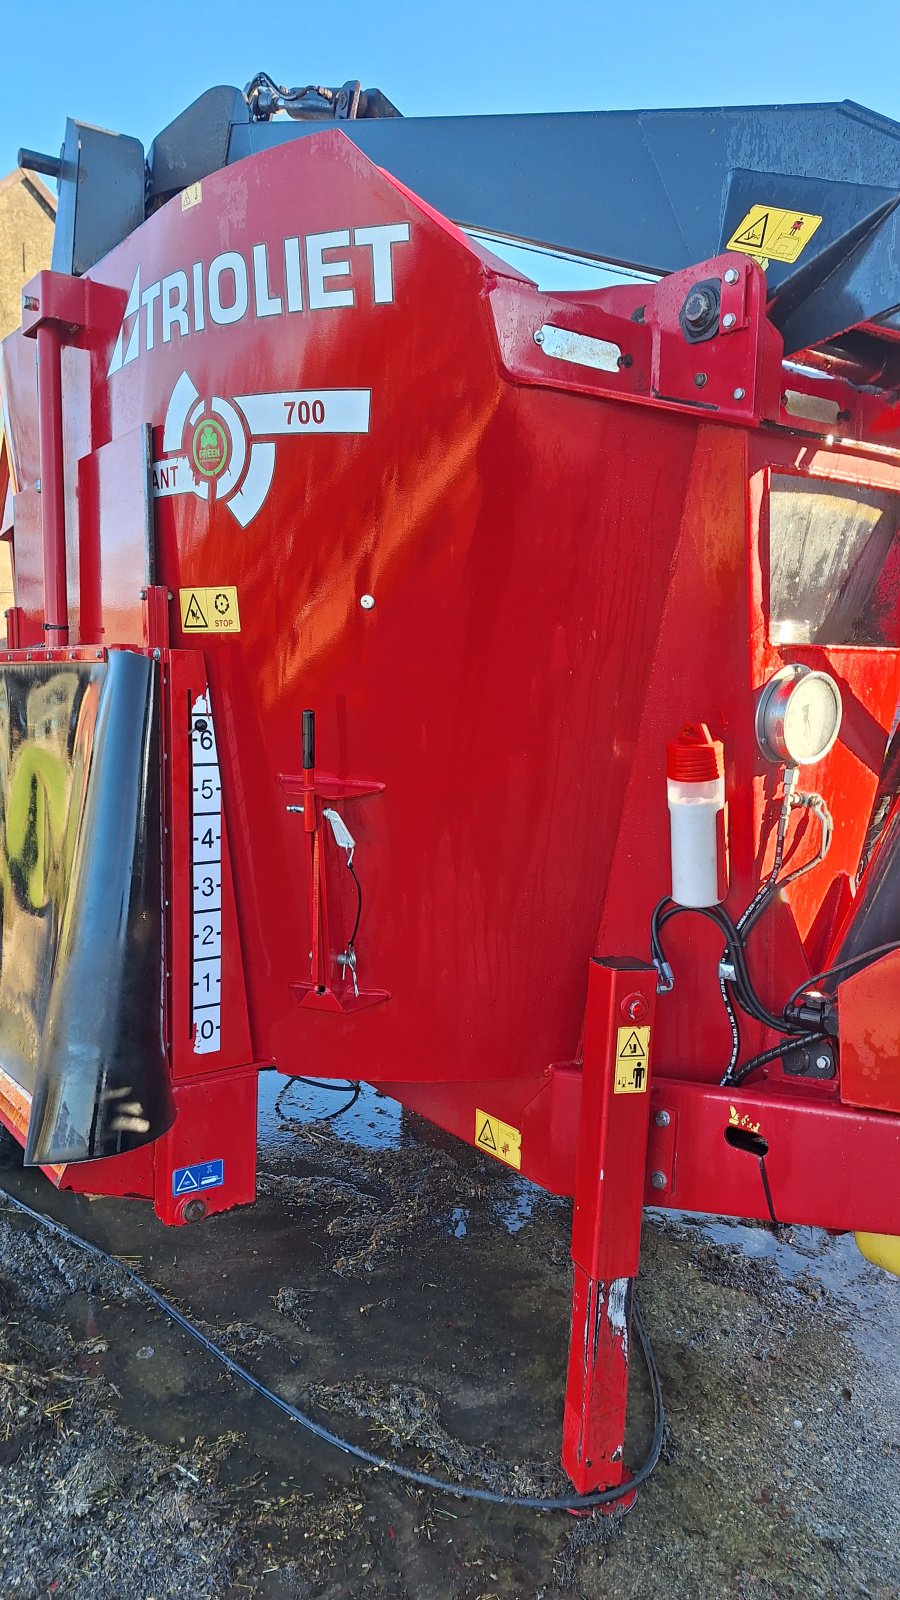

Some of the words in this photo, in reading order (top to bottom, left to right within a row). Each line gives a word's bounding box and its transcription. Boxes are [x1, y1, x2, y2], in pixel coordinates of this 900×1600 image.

[141, 222, 410, 351] TRIOLIET
[284, 400, 325, 425] 700
[200, 730, 213, 750] 6
[201, 779, 213, 799] 5
[201, 828, 214, 848] 4
[201, 877, 214, 897] 3
[202, 925, 214, 945] 2
[202, 972, 210, 992] 1
[200, 1020, 213, 1039] 0
